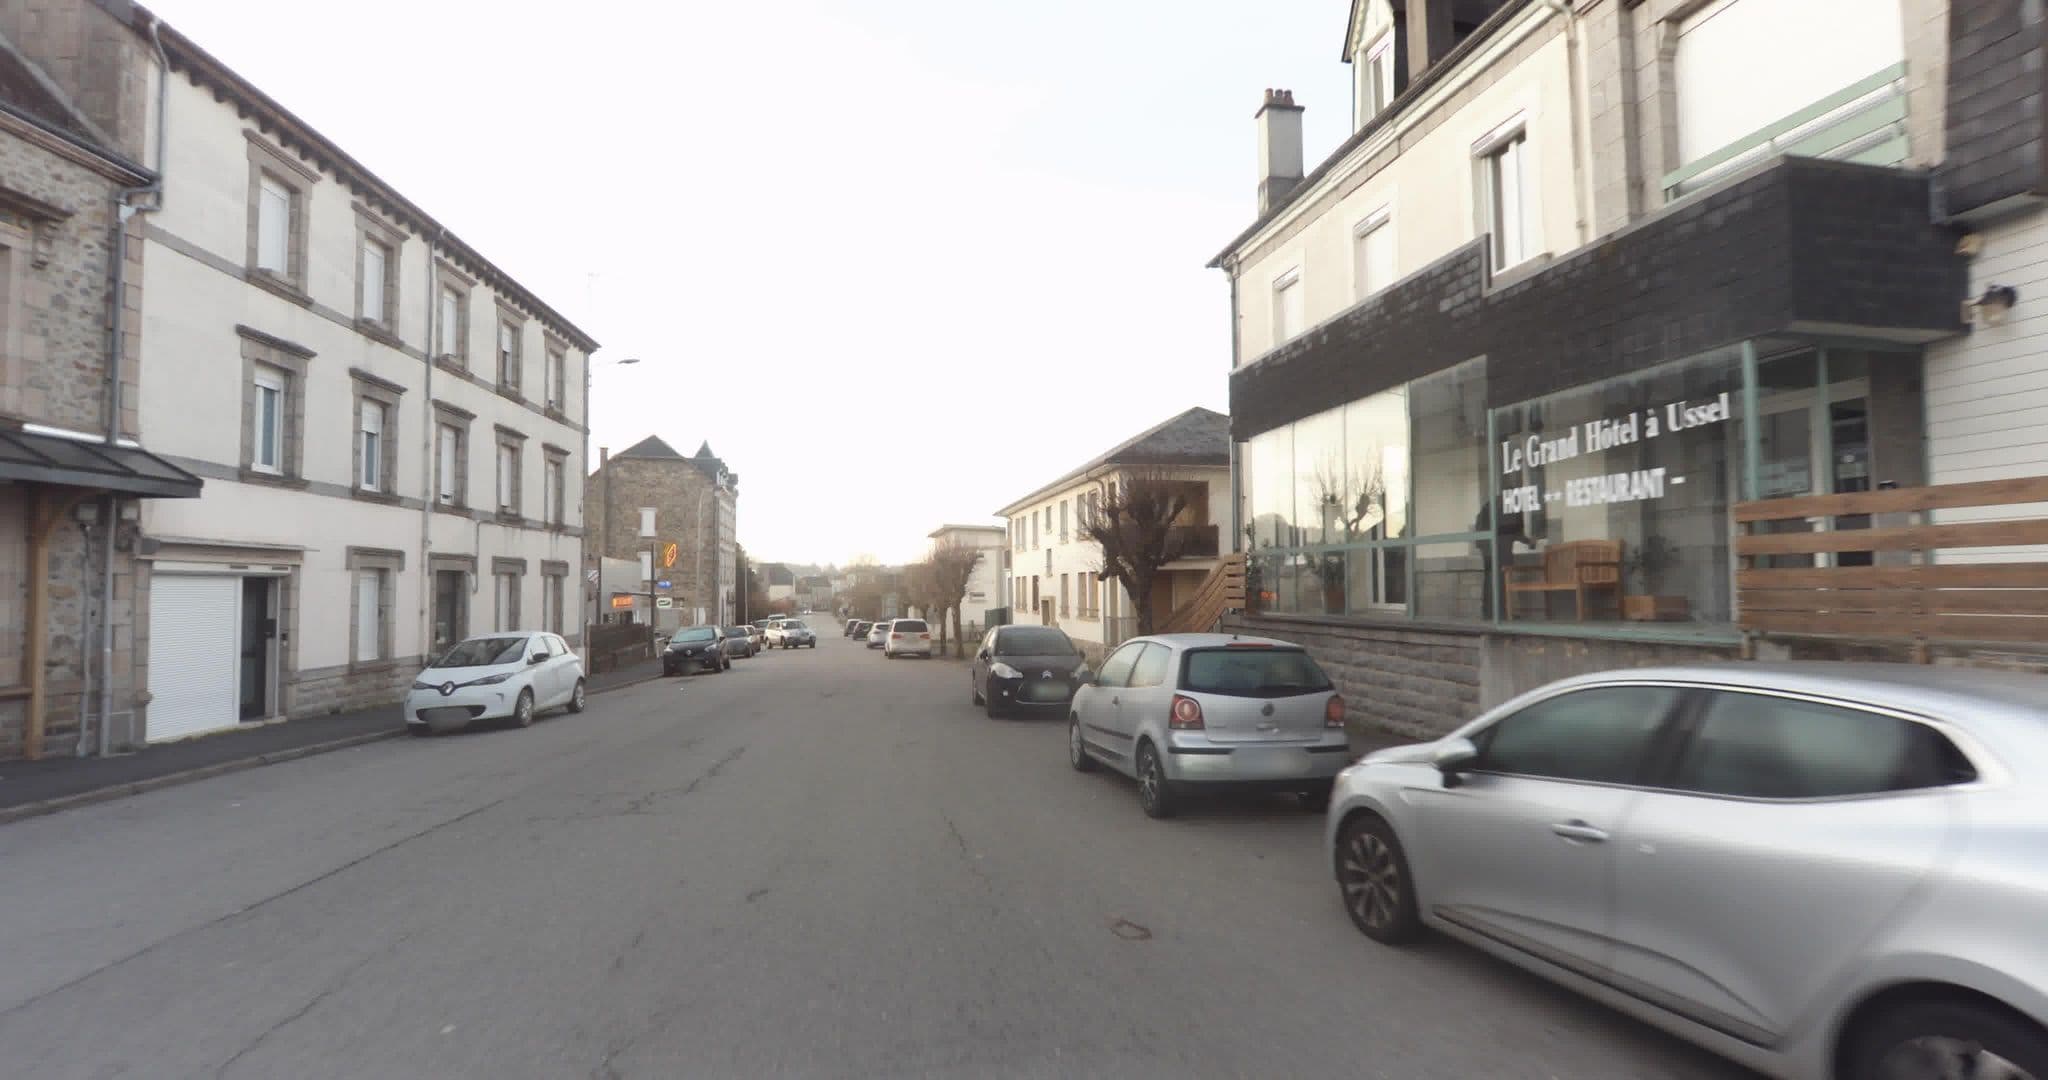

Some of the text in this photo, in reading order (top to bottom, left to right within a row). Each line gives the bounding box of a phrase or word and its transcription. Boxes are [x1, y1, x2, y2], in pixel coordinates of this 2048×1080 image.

[1502, 392, 1730, 474] Le Grand Hôtel à Ussel
[1502, 467, 1665, 514] HOTEL RESTAURANT
